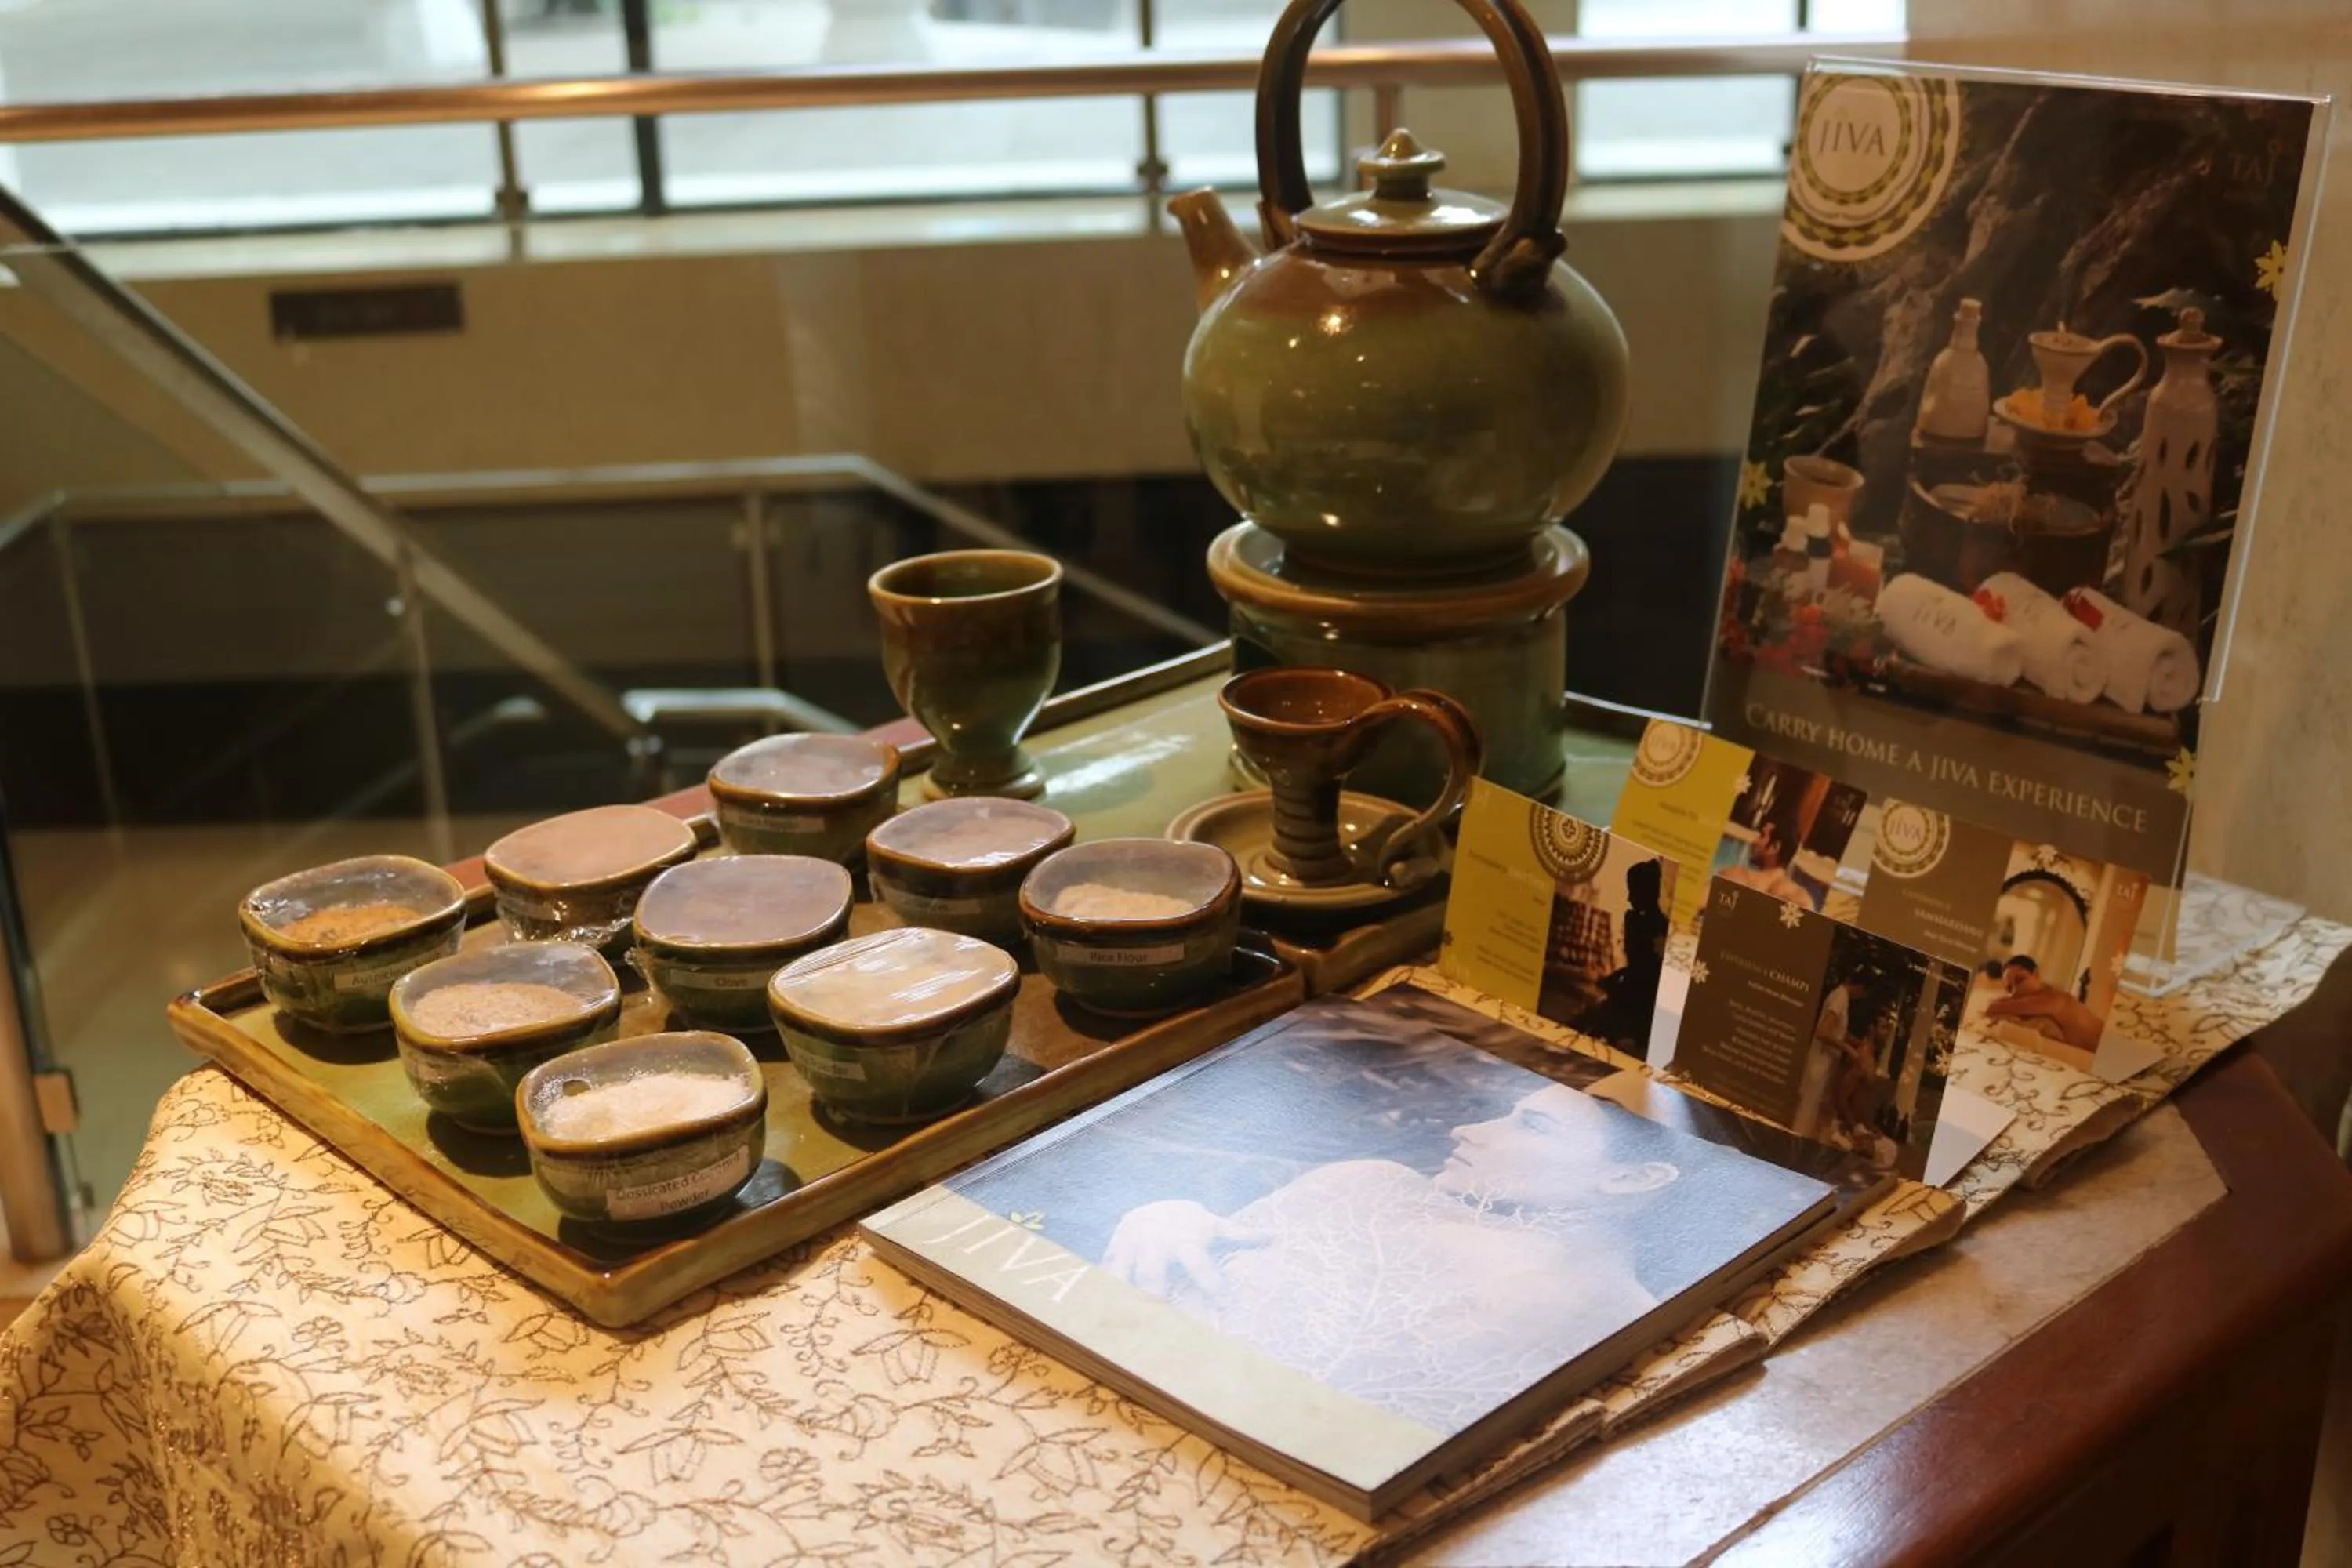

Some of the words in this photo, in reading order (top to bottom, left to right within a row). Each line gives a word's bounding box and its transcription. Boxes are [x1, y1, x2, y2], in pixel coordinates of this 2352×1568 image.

[2227, 139, 2282, 189] TAJ
[1745, 703, 1822, 743] CARRY
[1827, 725, 1900, 766] HOME
[1905, 749, 1922, 772] A
[1929, 753, 1979, 789] JIVA
[1988, 770, 2148, 834] EXPERIENCE
[1090, 951, 1114, 962] Rice
[1116, 951, 1150, 963] Flour
[660, 1189, 710, 1213] Powder
[923, 1214, 1091, 1305] JIVA
